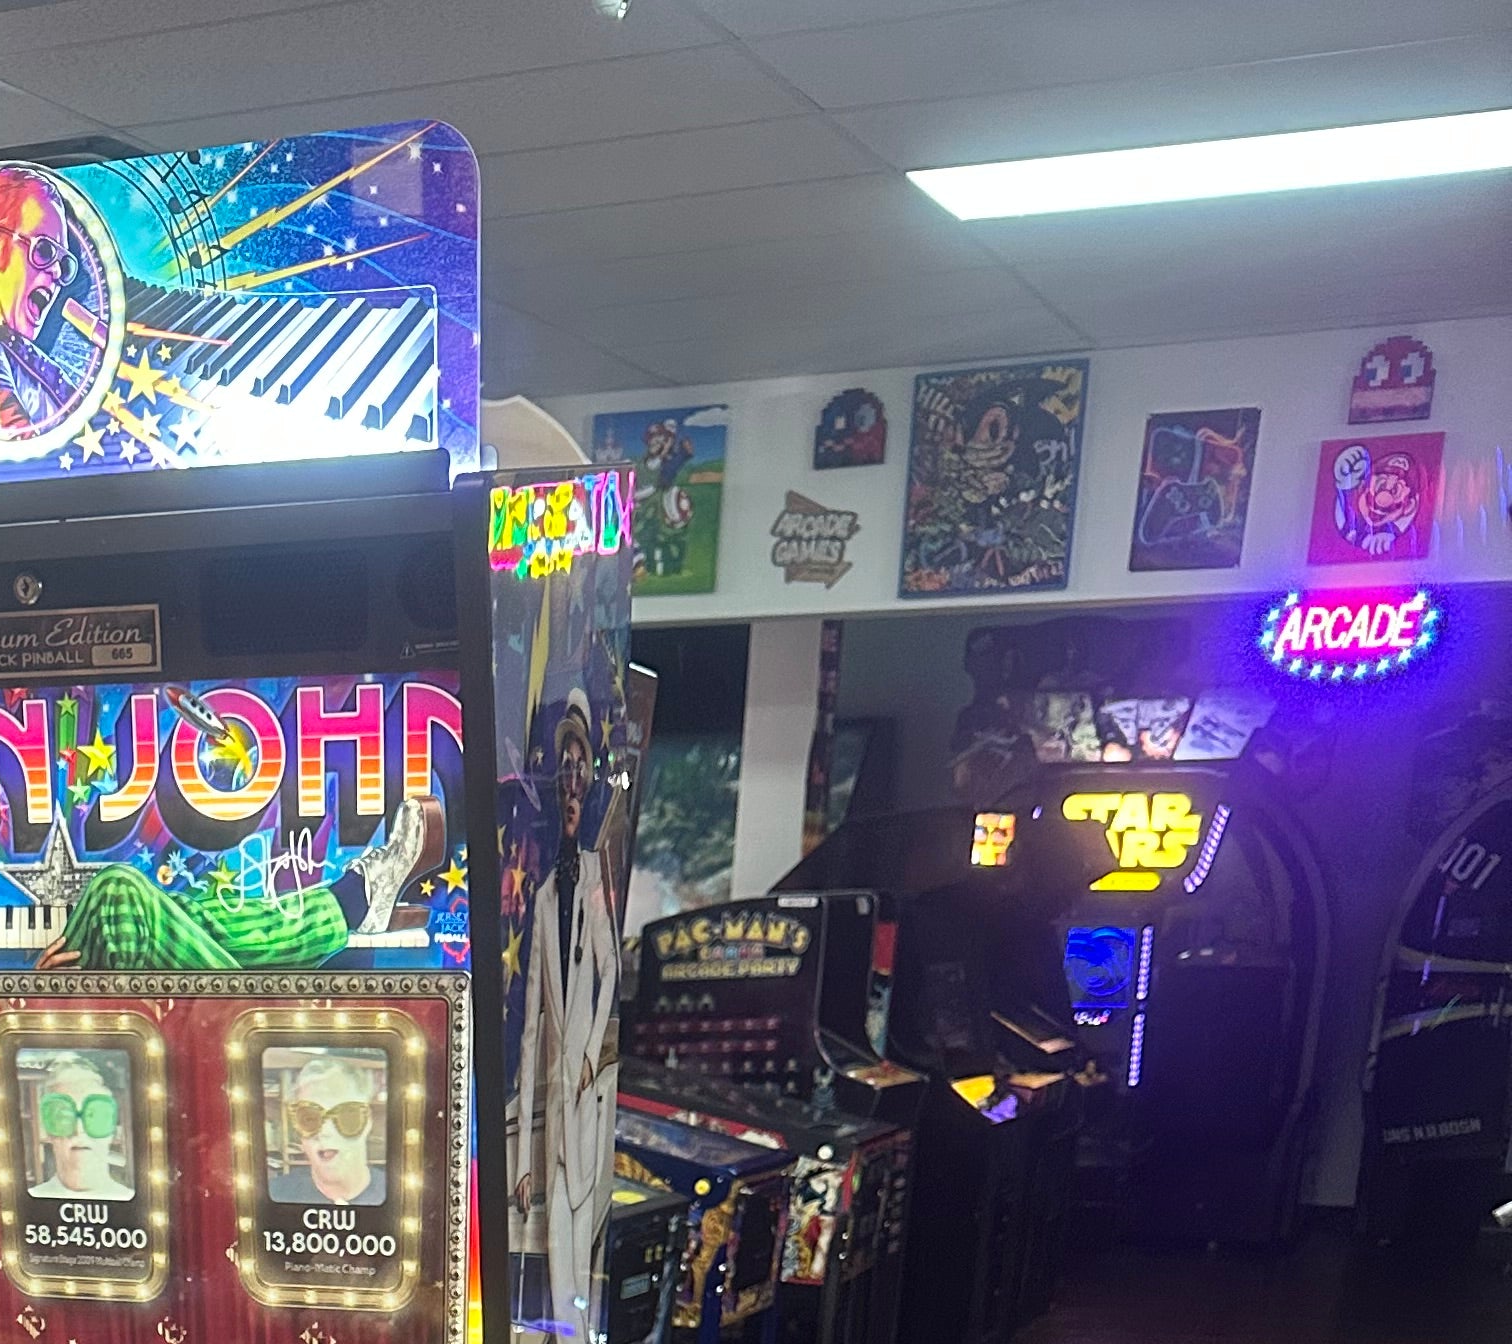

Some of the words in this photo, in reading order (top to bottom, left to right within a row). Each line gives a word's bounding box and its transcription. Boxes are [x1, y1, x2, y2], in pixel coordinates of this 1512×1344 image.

[775, 511, 855, 538] ARCADE
[774, 539, 841, 562] GAMES
[45, 616, 141, 646] Edition
[1274, 600, 1424, 653] ARCADE
[22, 650, 84, 667] PINBALL
[99, 681, 464, 823] JOHN
[655, 912, 809, 955] PAC-MAN'S
[661, 960, 735, 979] ARCADE
[737, 957, 801, 977] PARTY
[60, 1203, 108, 1224] CRW
[303, 1209, 356, 1230] CRW
[25, 1225, 147, 1249] 58,545,000
[263, 1231, 396, 1257] 13,800,000
[342, 1264, 376, 1276] Champ
